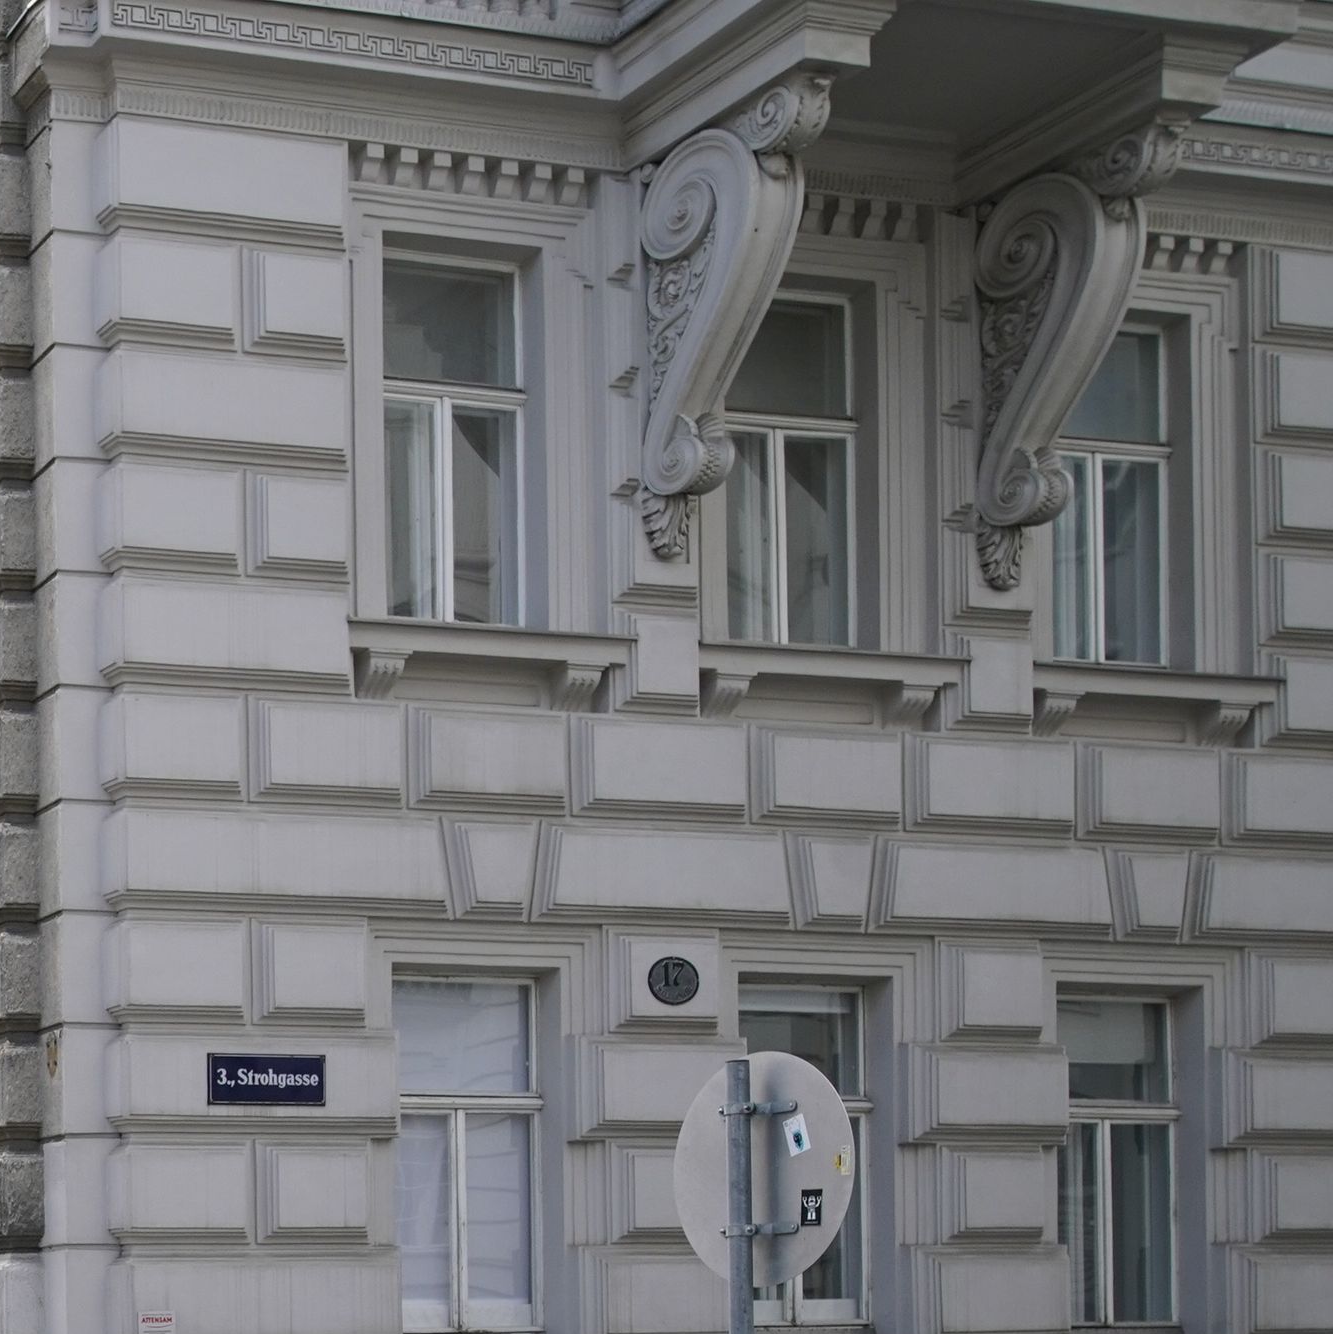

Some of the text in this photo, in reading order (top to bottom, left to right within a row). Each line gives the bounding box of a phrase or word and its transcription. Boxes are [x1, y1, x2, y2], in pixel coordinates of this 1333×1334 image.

[663, 961, 685, 987] 17
[237, 1068, 319, 1089] Strohgasse
[141, 1316, 173, 1324] ATTENSAM
